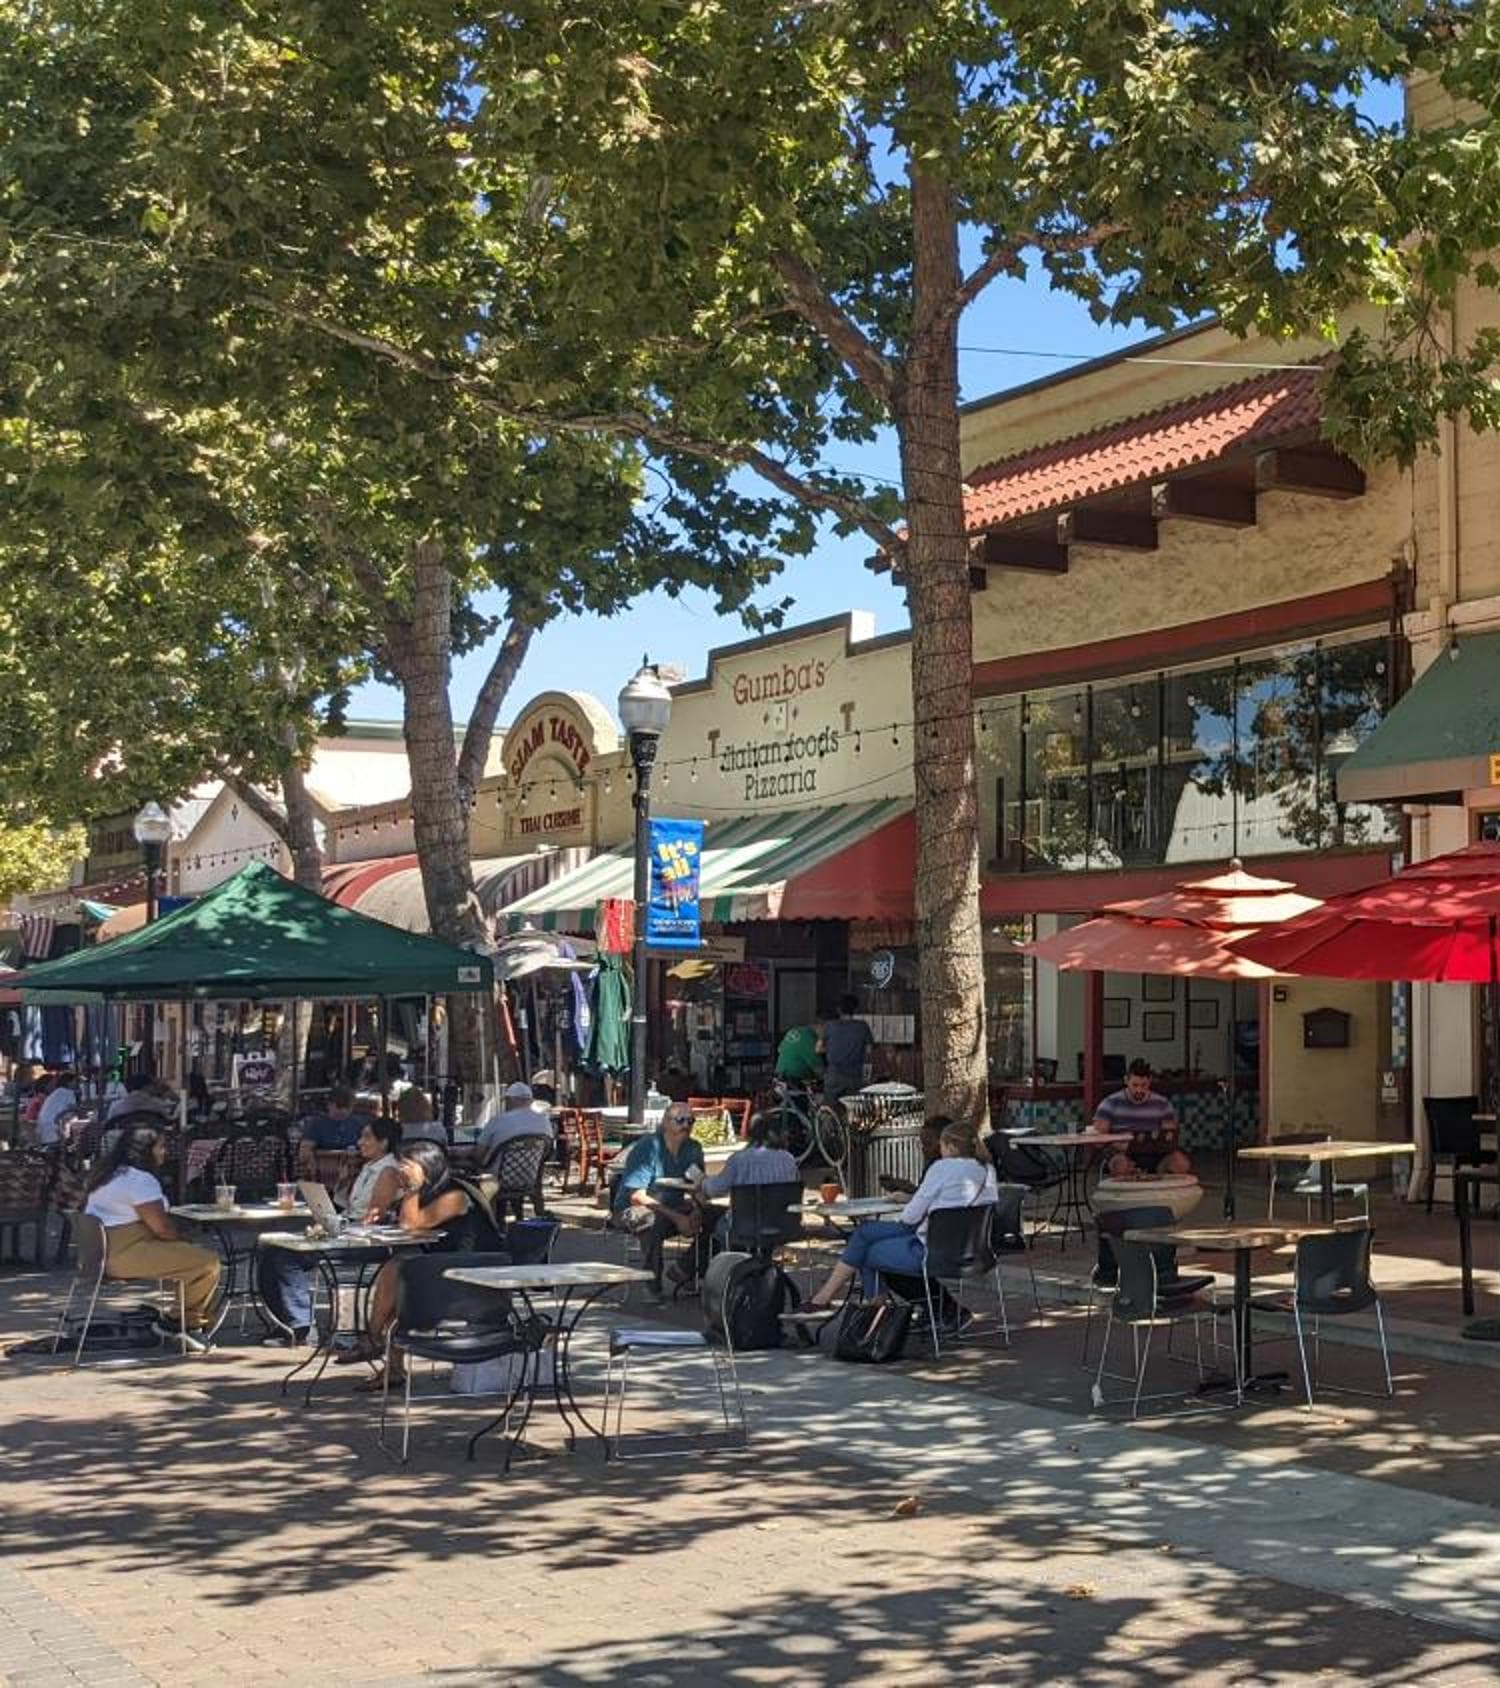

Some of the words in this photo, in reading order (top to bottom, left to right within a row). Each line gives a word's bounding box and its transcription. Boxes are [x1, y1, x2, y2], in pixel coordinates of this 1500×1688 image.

[733, 659, 825, 705] Gumba's
[511, 721, 545, 784] SIAM
[745, 766, 817, 802] Pizzaria
